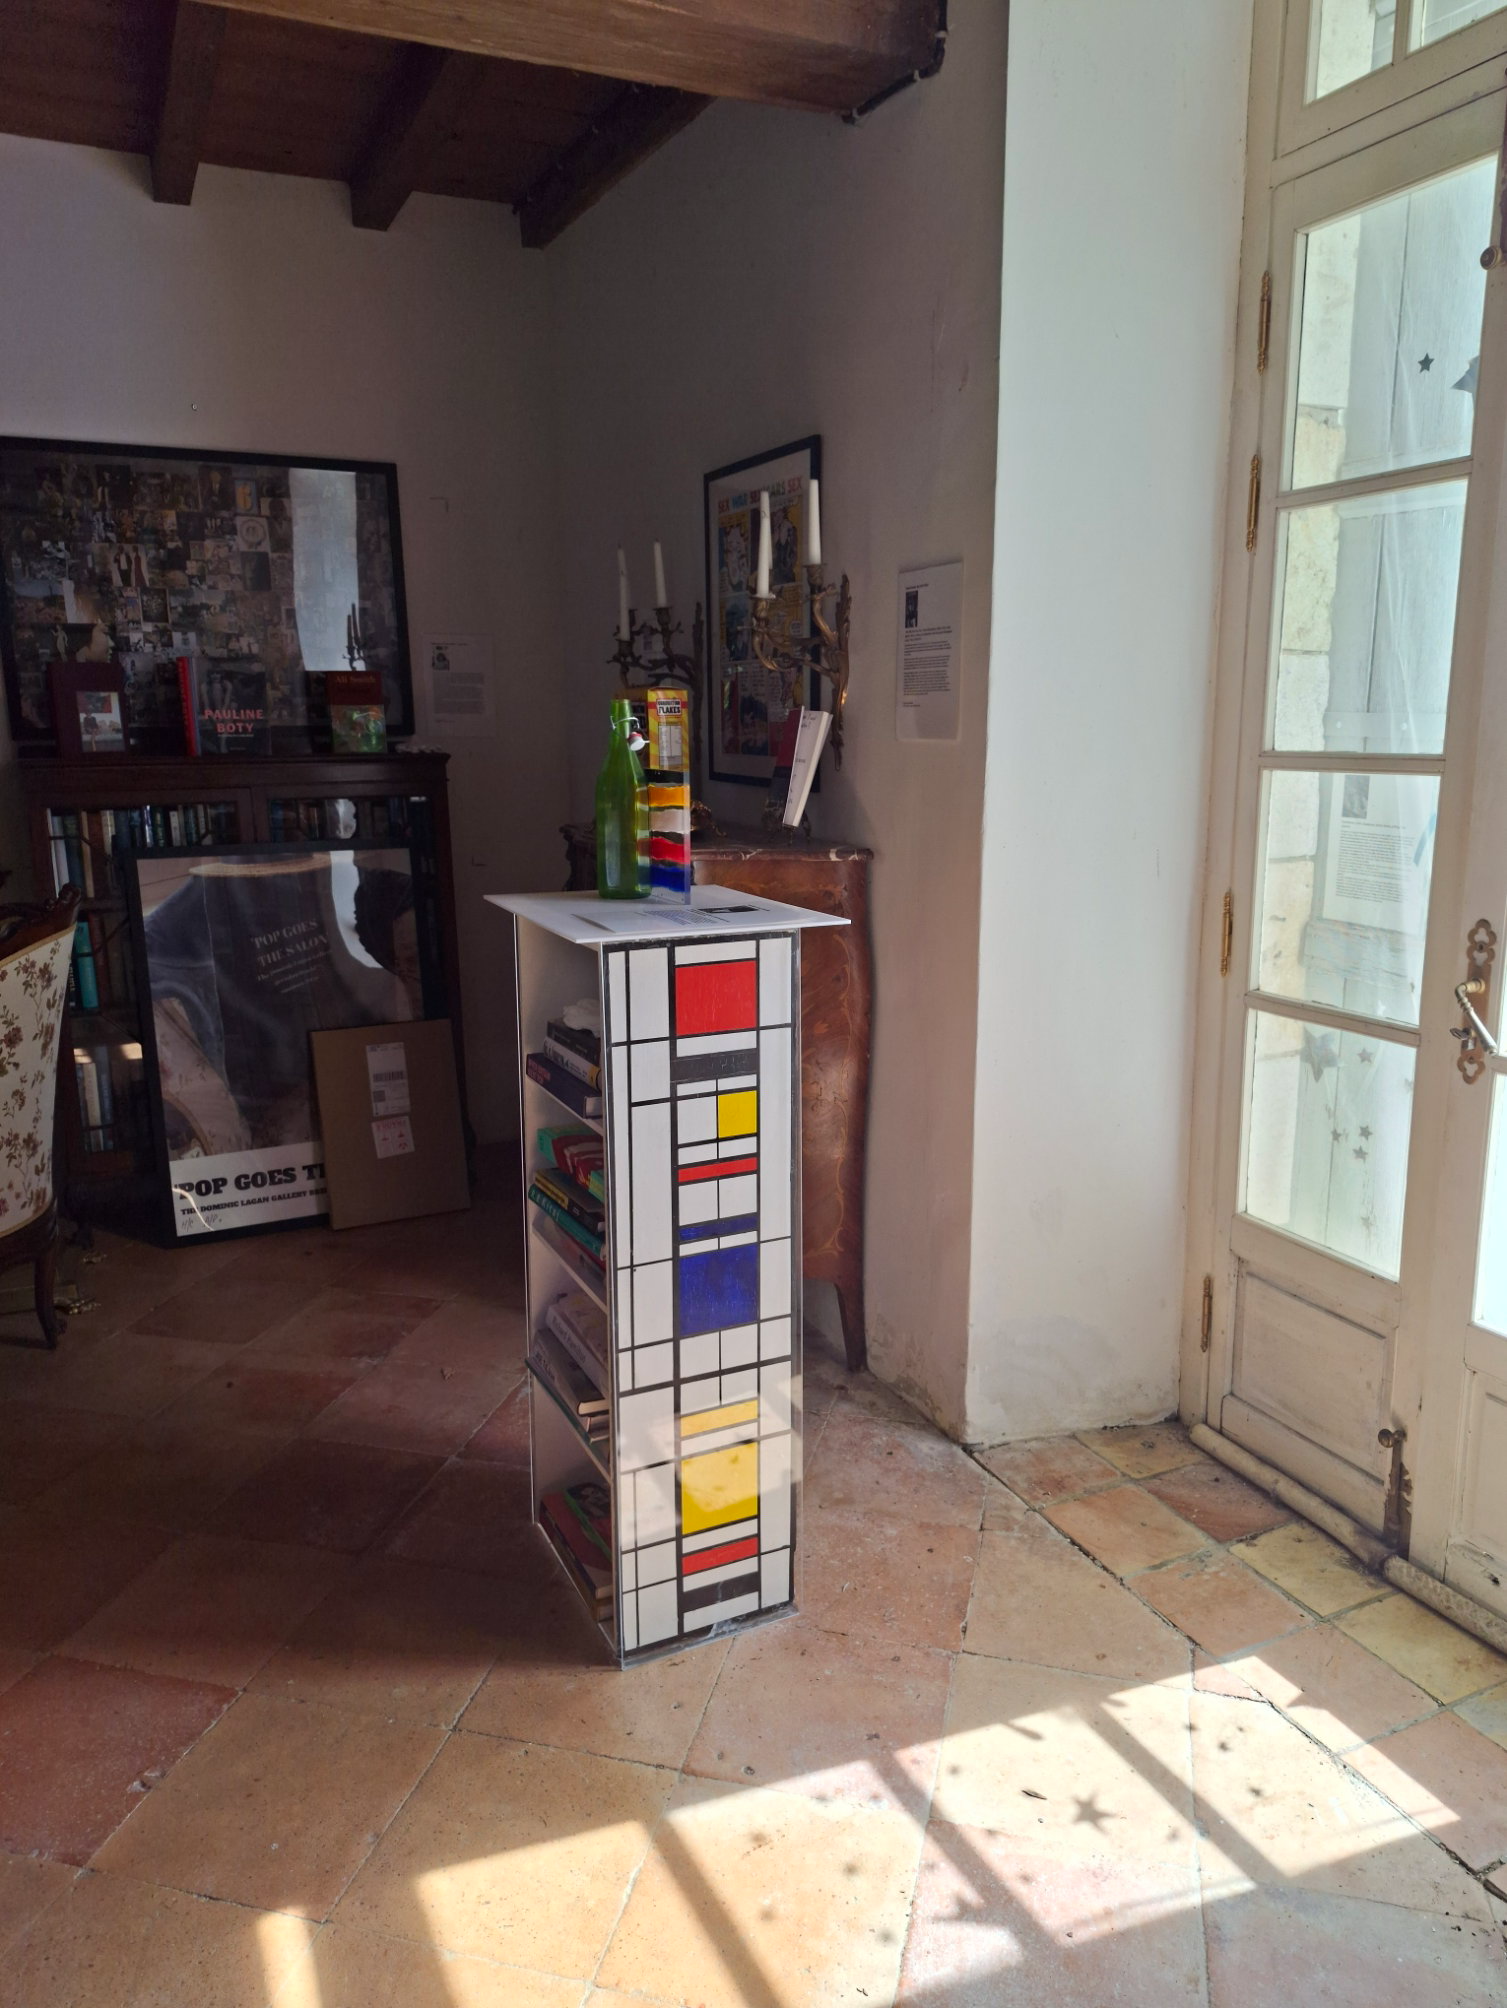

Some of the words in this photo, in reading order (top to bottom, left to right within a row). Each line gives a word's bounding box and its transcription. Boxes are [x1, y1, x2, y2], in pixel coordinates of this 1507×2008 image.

[203, 708, 264, 720] PAULINE
[215, 722, 254, 734] BOTY
[282, 919, 319, 938] GOES
[257, 948, 283, 967] THE
[234, 1167, 297, 1190] GOES
[200, 1201, 239, 1212] DOMINIC
[241, 1196, 270, 1206] LAGAN
[271, 1190, 307, 1201] GALLERY
